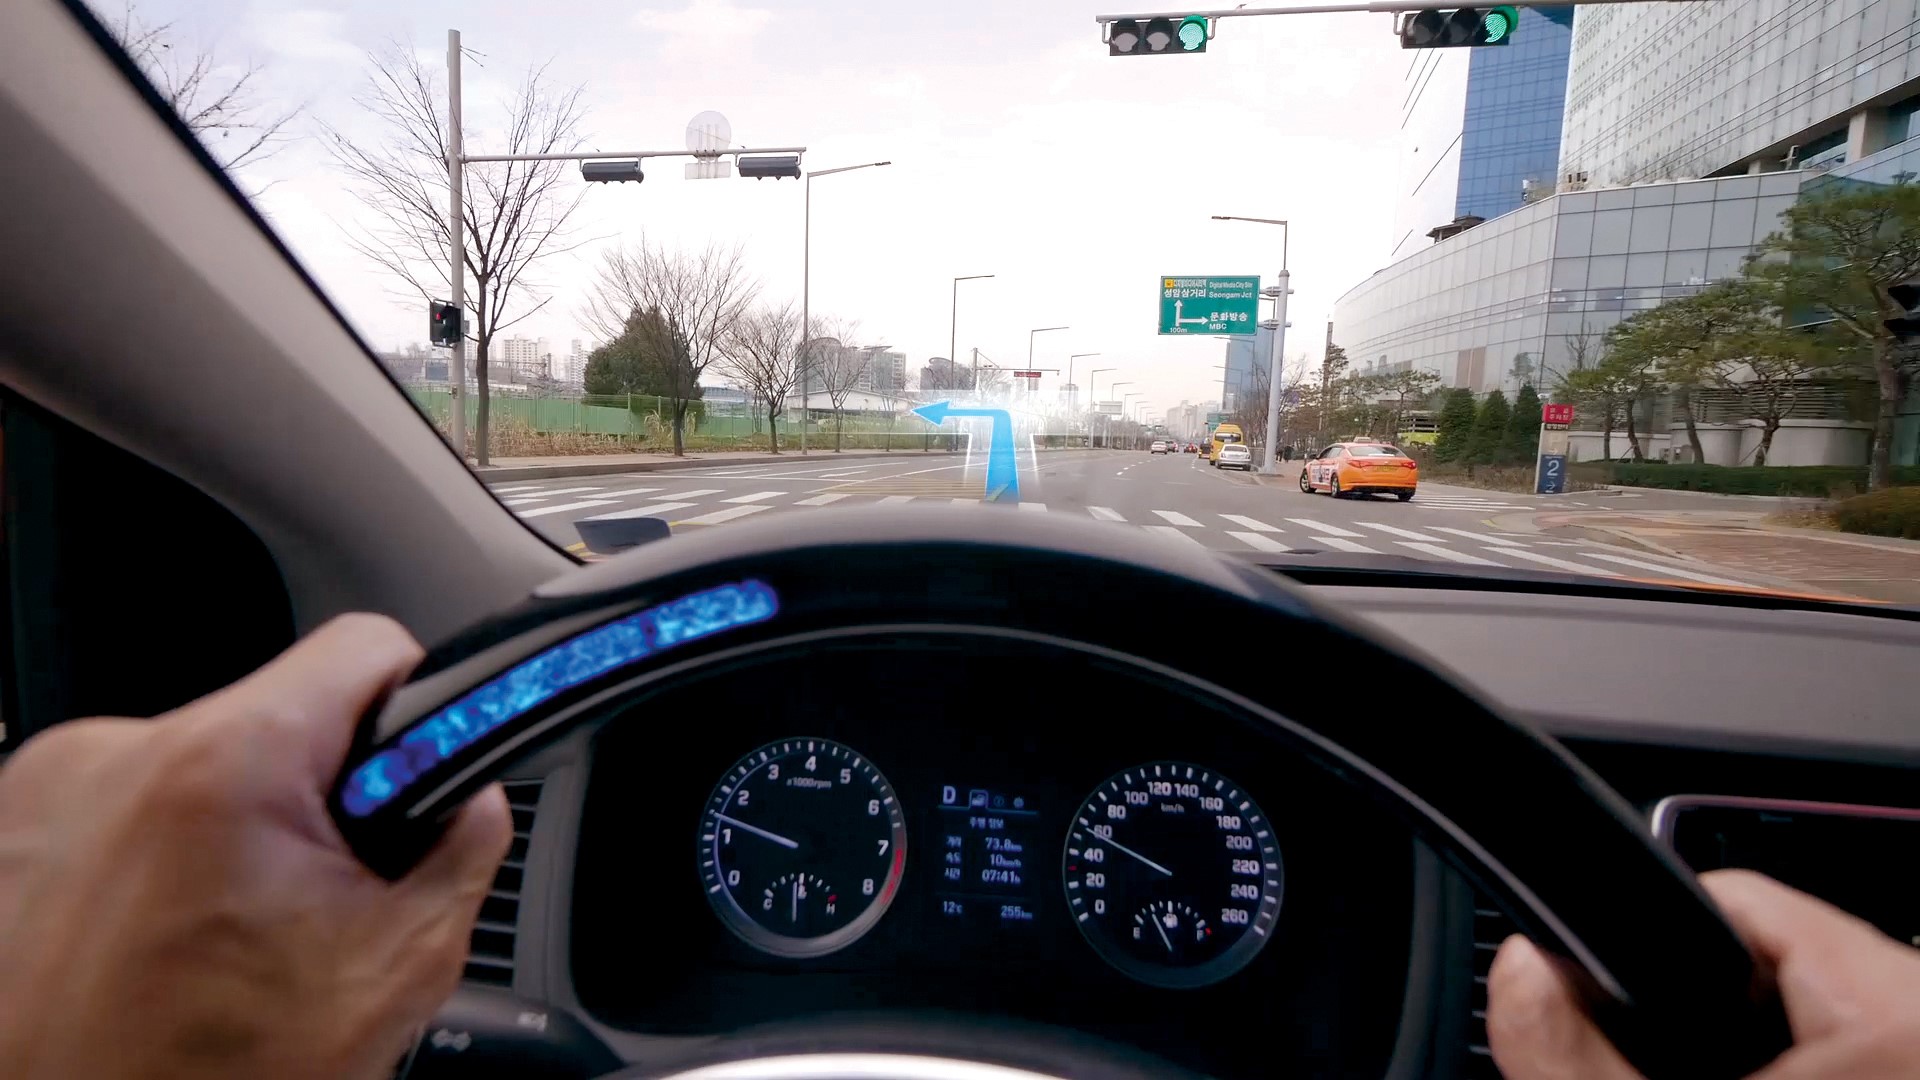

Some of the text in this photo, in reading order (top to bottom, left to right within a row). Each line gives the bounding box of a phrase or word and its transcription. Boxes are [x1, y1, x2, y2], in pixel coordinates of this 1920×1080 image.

[1164, 289, 1206, 298] 성암삼거리
[1210, 312, 1248, 322] 문화방송
[1547, 460, 1559, 476] 2
[805, 756, 816, 771] 4
[768, 764, 779, 780] 3
[840, 768, 851, 784] 5
[943, 785, 956, 804] D
[1147, 782, 1172, 796] 120
[1174, 783, 1199, 798] 140
[737, 790, 749, 805] 2
[1124, 790, 1148, 804] 100
[1199, 797, 1224, 811] 160
[868, 799, 879, 815] 6
[1108, 804, 1126, 819] 80
[1160, 802, 1184, 813] km/h
[1216, 815, 1241, 829] 180
[722, 828, 731, 844] 1
[1094, 825, 1112, 839] 60
[877, 840, 888, 856] 7
[1226, 835, 1252, 850] 200
[1084, 848, 1104, 863] 40
[1232, 859, 1260, 875] 220
[728, 870, 740, 886] 0
[1086, 872, 1105, 888] 20
[862, 879, 873, 895] 8
[1231, 884, 1258, 900] 240
[763, 898, 772, 910] C
[826, 903, 835, 915] H
[1095, 899, 1105, 914] 0
[1221, 908, 1248, 924] 260
[1133, 926, 1140, 939] E
[1197, 929, 1204, 941] F
